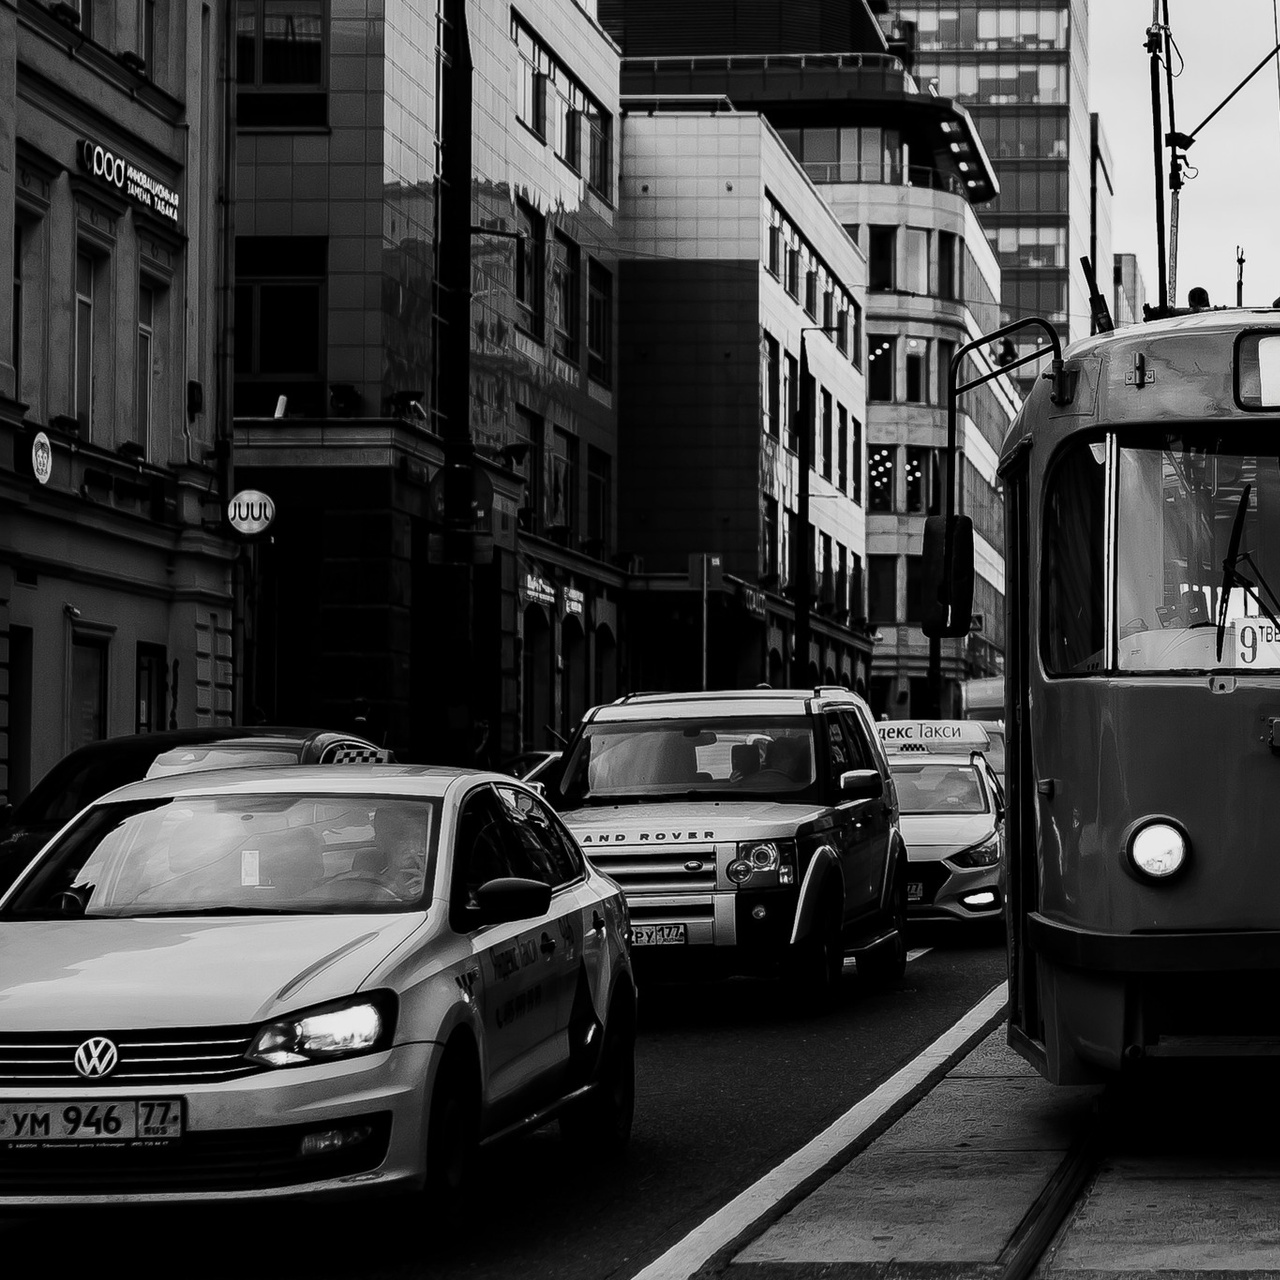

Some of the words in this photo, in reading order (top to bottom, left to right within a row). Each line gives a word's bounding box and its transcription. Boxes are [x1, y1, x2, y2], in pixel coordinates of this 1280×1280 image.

[126, 179, 151, 207] ЗАМЕНА
[154, 195, 178, 222] ТАБАКА
[232, 502, 270, 521] JUUL
[1240, 625, 1258, 664] 9
[879, 726, 913, 741] декс
[917, 723, 961, 739] Такси
[583, 834, 626, 843] AND
[639, 831, 715, 840] ROVER
[63, 1105, 122, 1135] 946
[140, 1102, 171, 1125] 77
[144, 1126, 167, 1135] RUS
